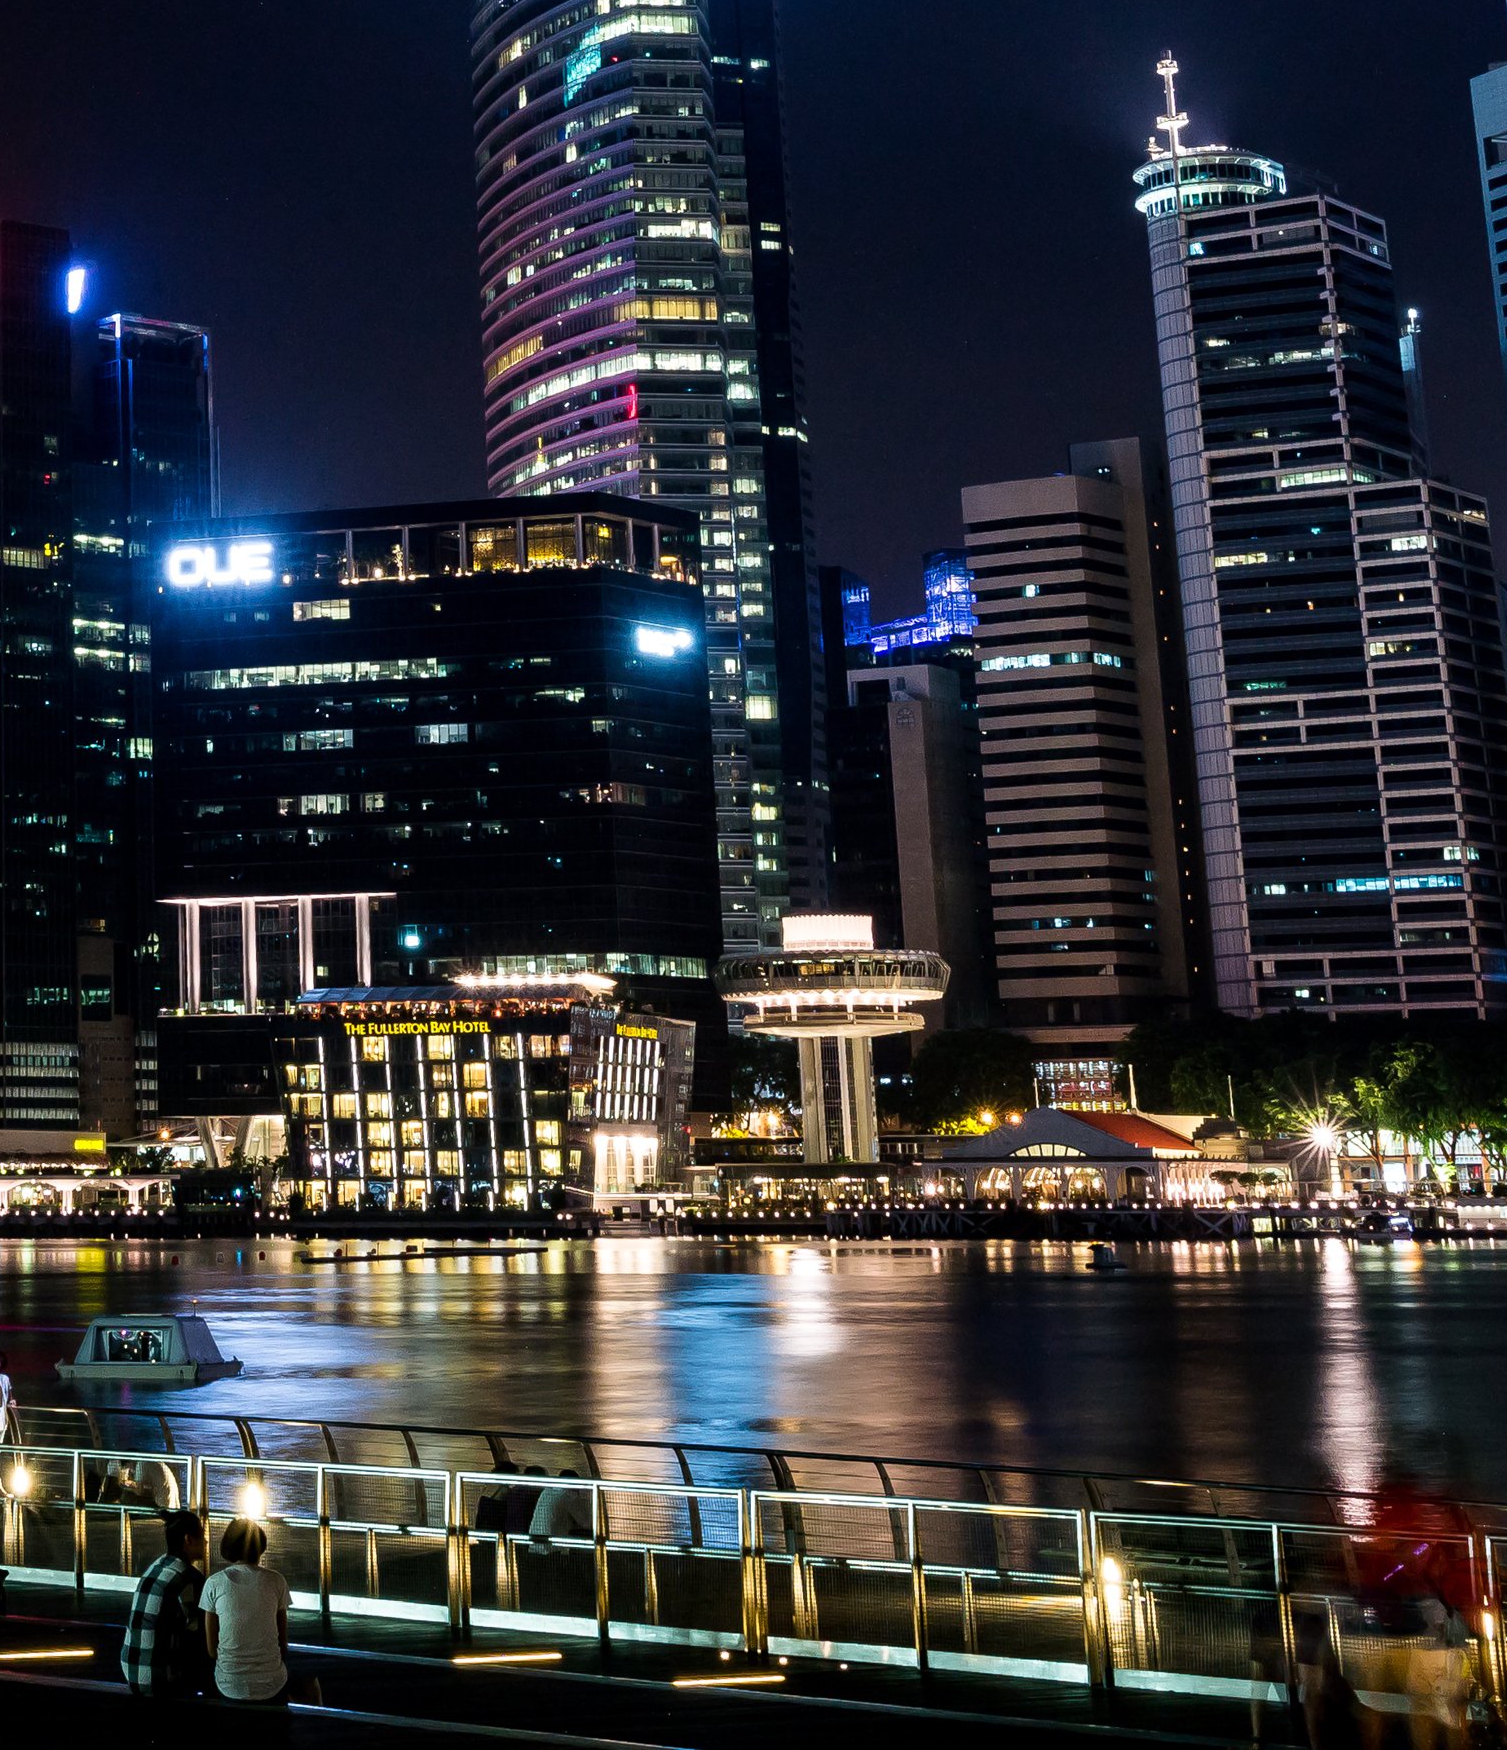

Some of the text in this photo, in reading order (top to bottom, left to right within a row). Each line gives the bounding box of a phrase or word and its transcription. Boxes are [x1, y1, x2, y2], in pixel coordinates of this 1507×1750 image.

[169, 544, 273, 585] OUE
[344, 1020, 492, 1035] THE FULLERTON BAY HOTEL
